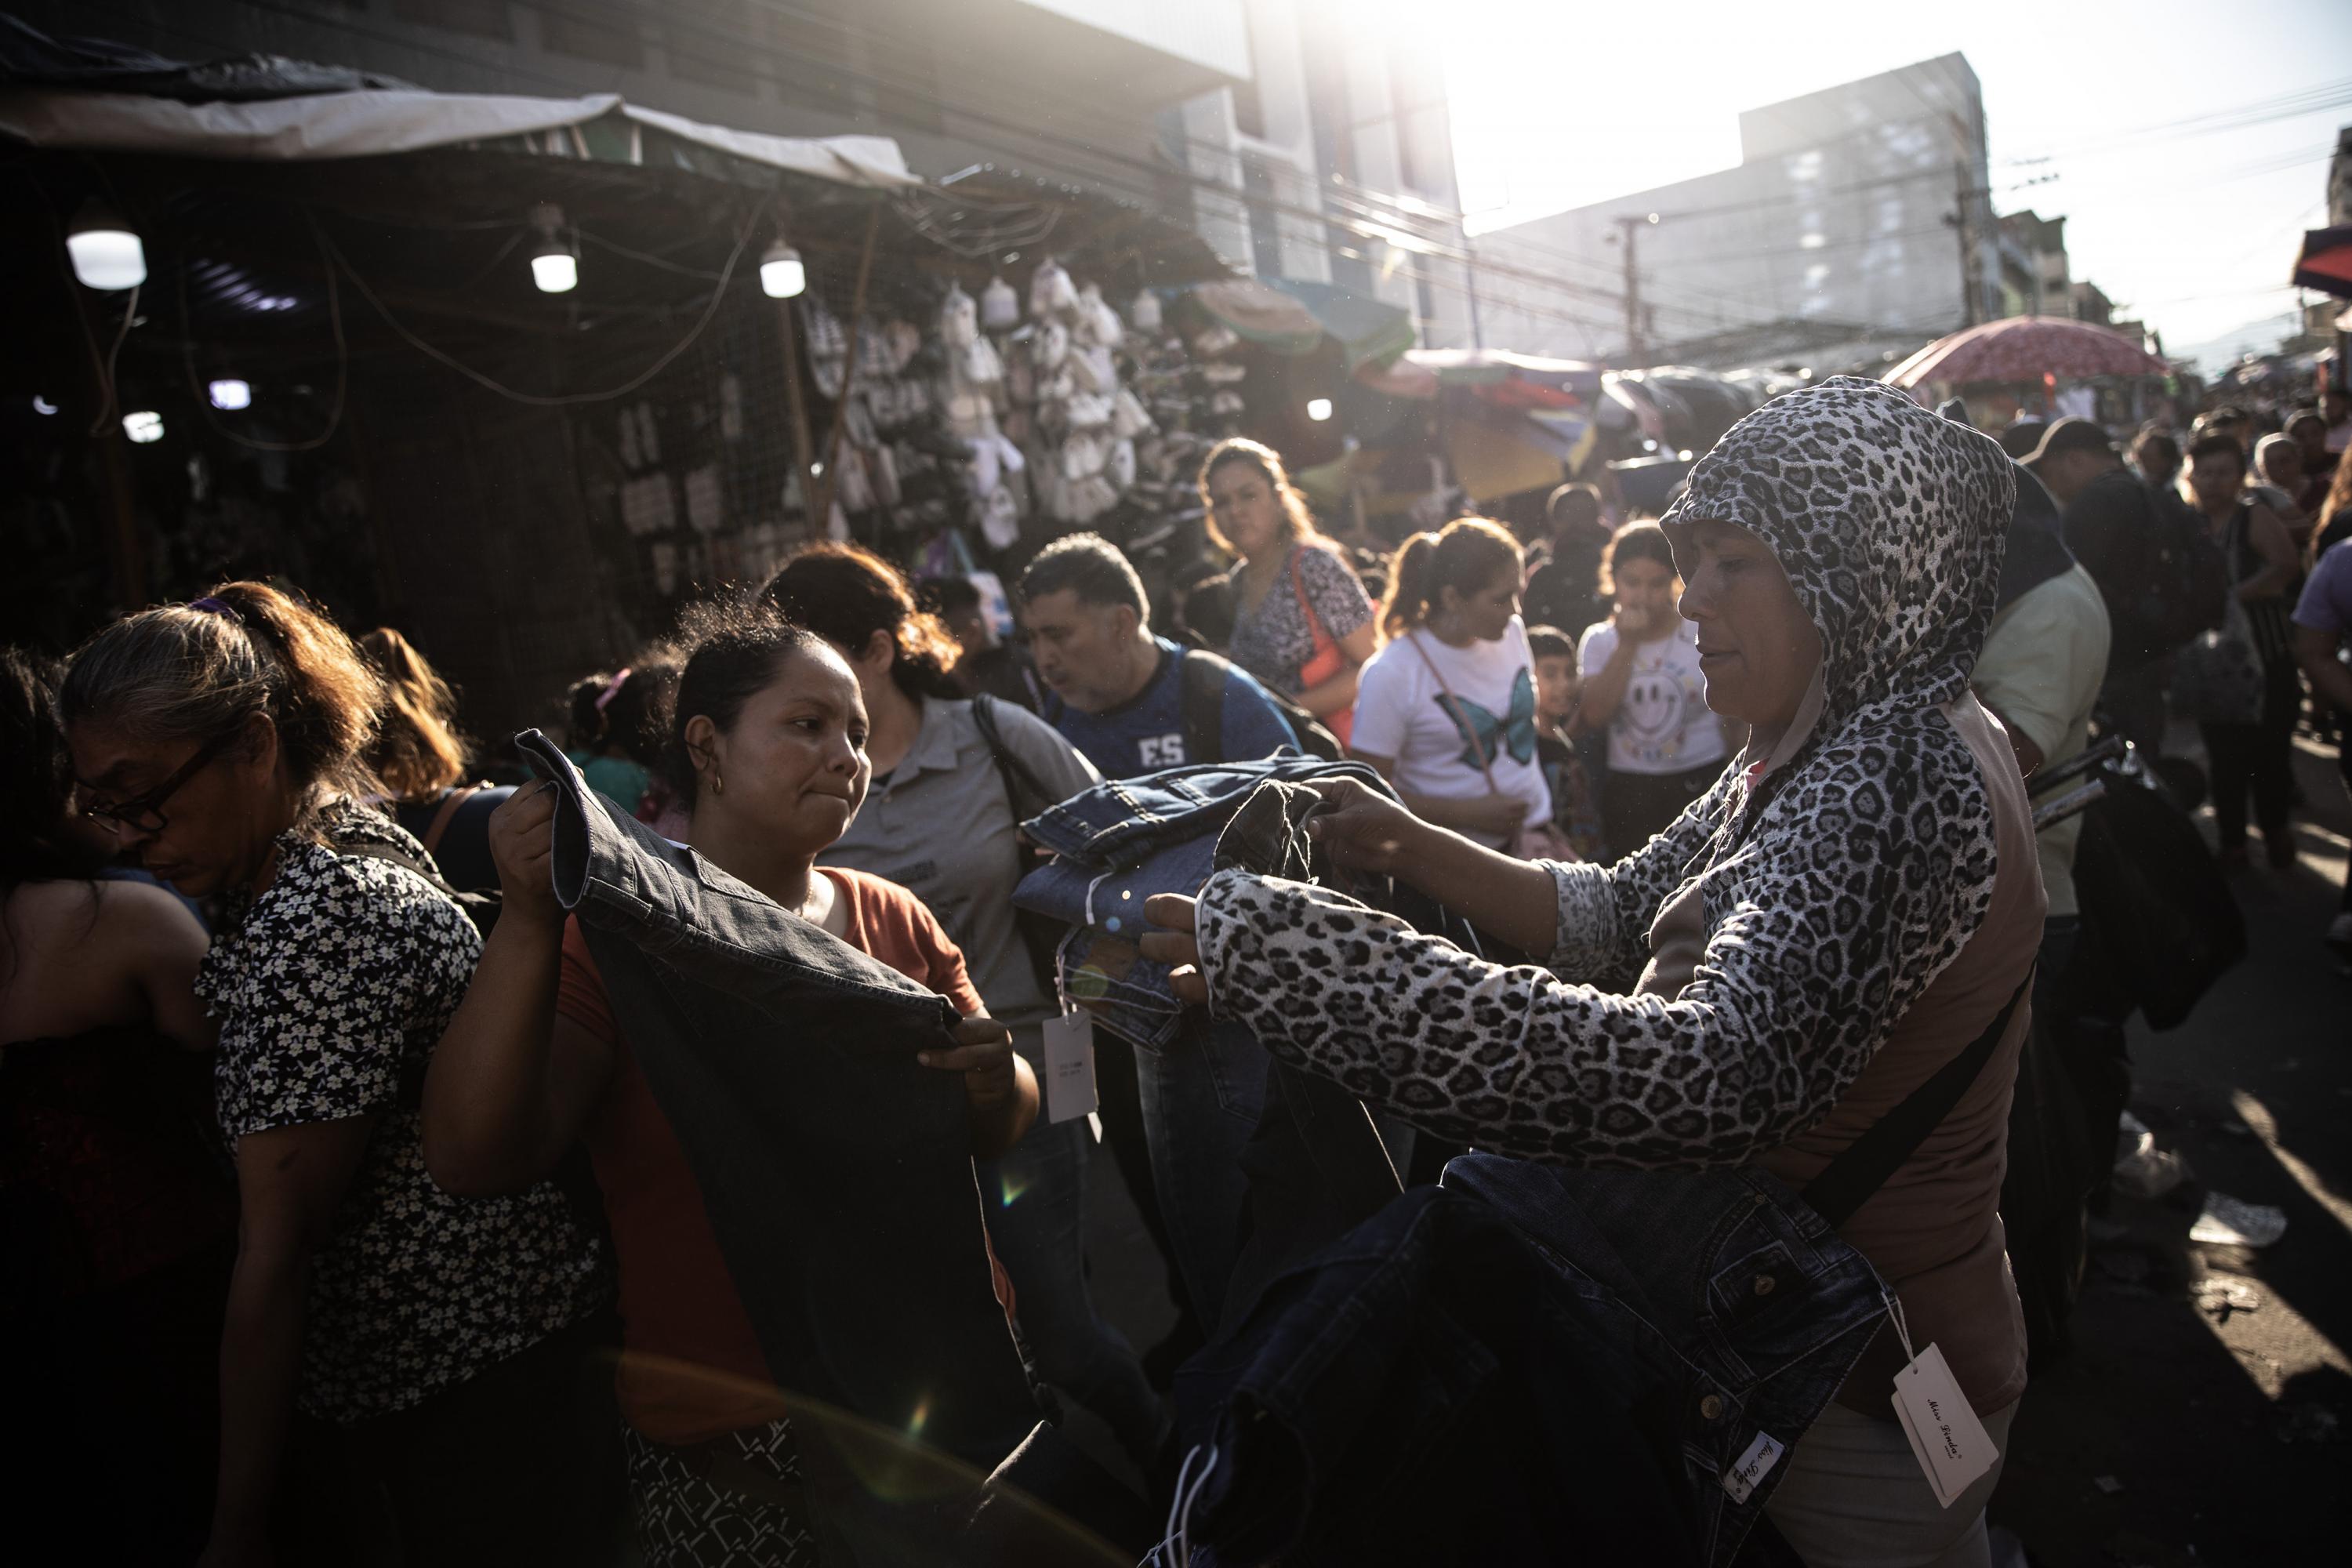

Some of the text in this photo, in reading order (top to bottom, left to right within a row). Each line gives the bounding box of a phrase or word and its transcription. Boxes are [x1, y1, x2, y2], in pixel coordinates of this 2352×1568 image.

[1927, 1399, 1942, 1421] Miss
[1940, 1425, 1958, 1455] Linda
[1737, 1459, 1759, 1486] Lina
